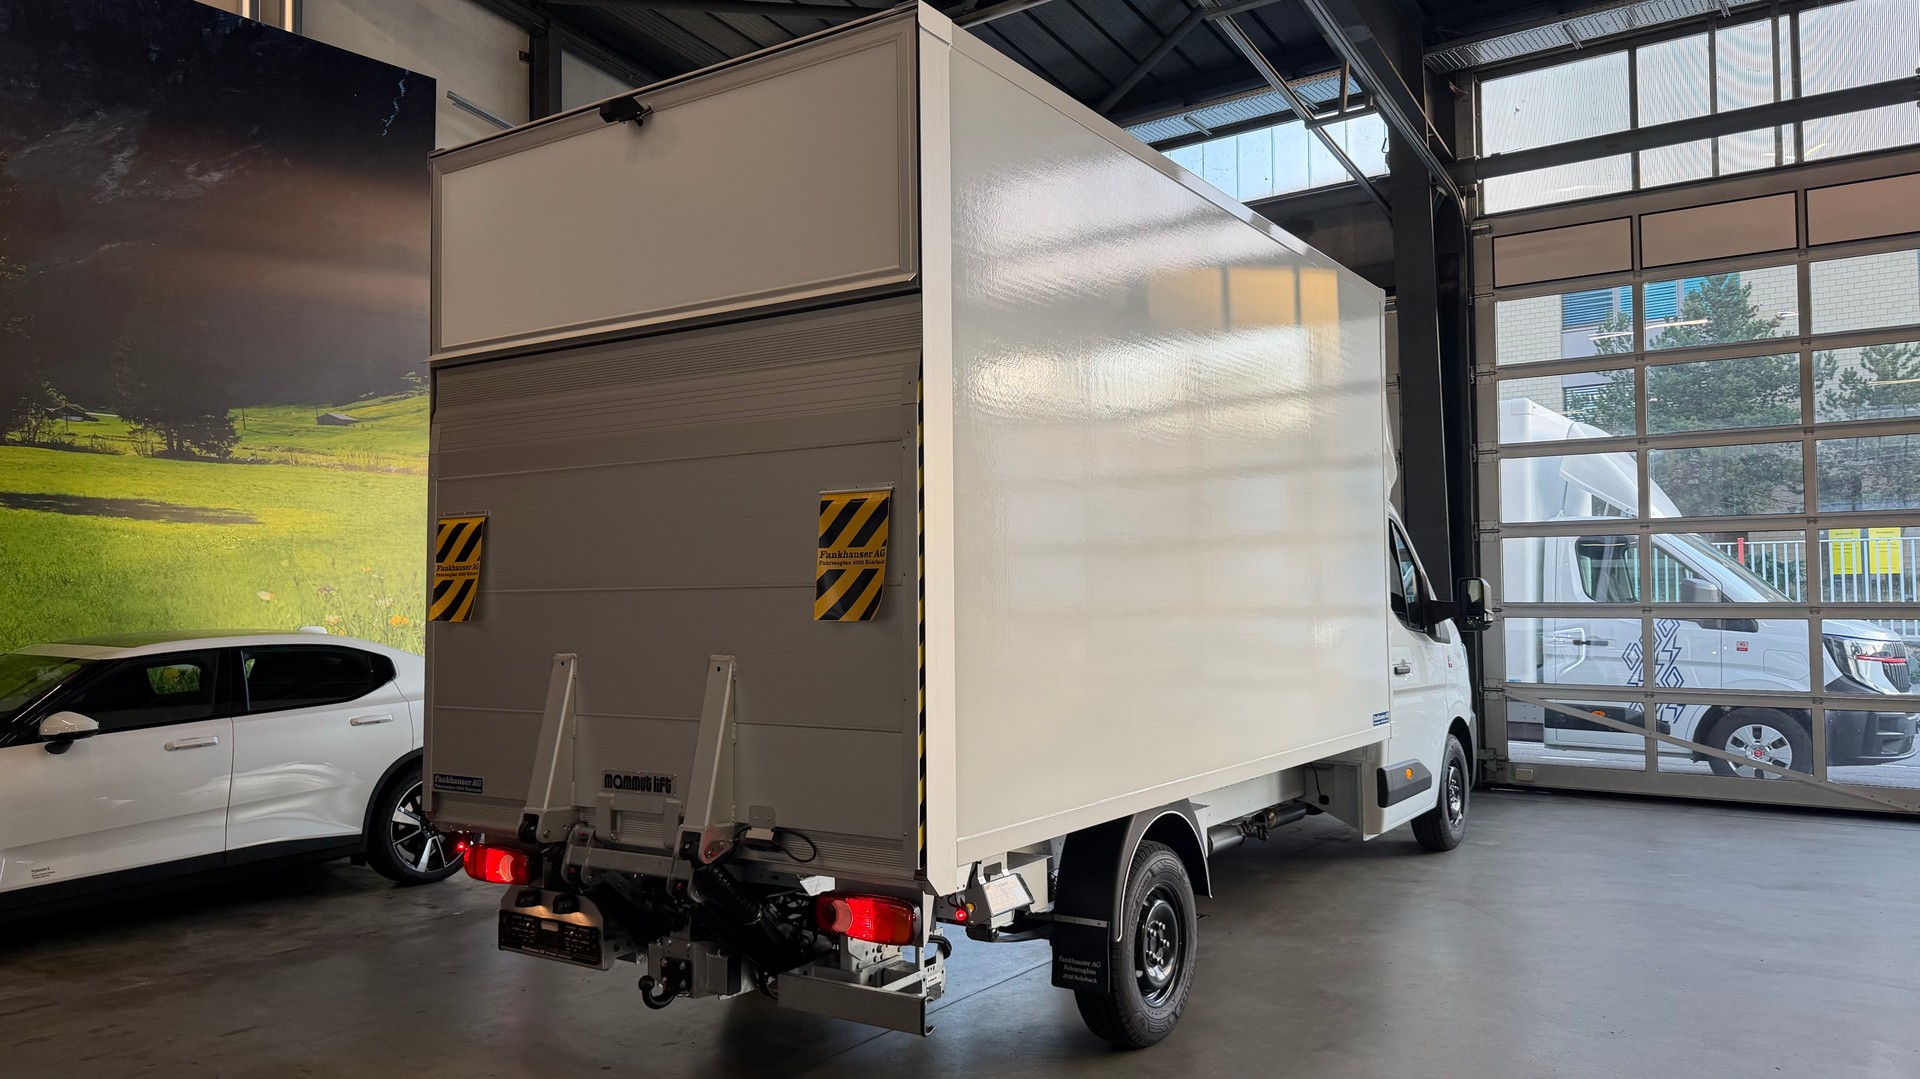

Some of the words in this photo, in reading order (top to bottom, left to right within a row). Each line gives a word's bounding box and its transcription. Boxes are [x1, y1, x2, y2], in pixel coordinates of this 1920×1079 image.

[819, 550, 873, 559] Fankhauser
[874, 548, 886, 558] AG
[436, 564, 472, 572] Fankhauser
[434, 775, 472, 786] Fankhauser
[472, 779, 482, 787] AG
[604, 773, 652, 792] mammut
[653, 775, 672, 794] lift
[1058, 955, 1091, 967] Fankhauser
